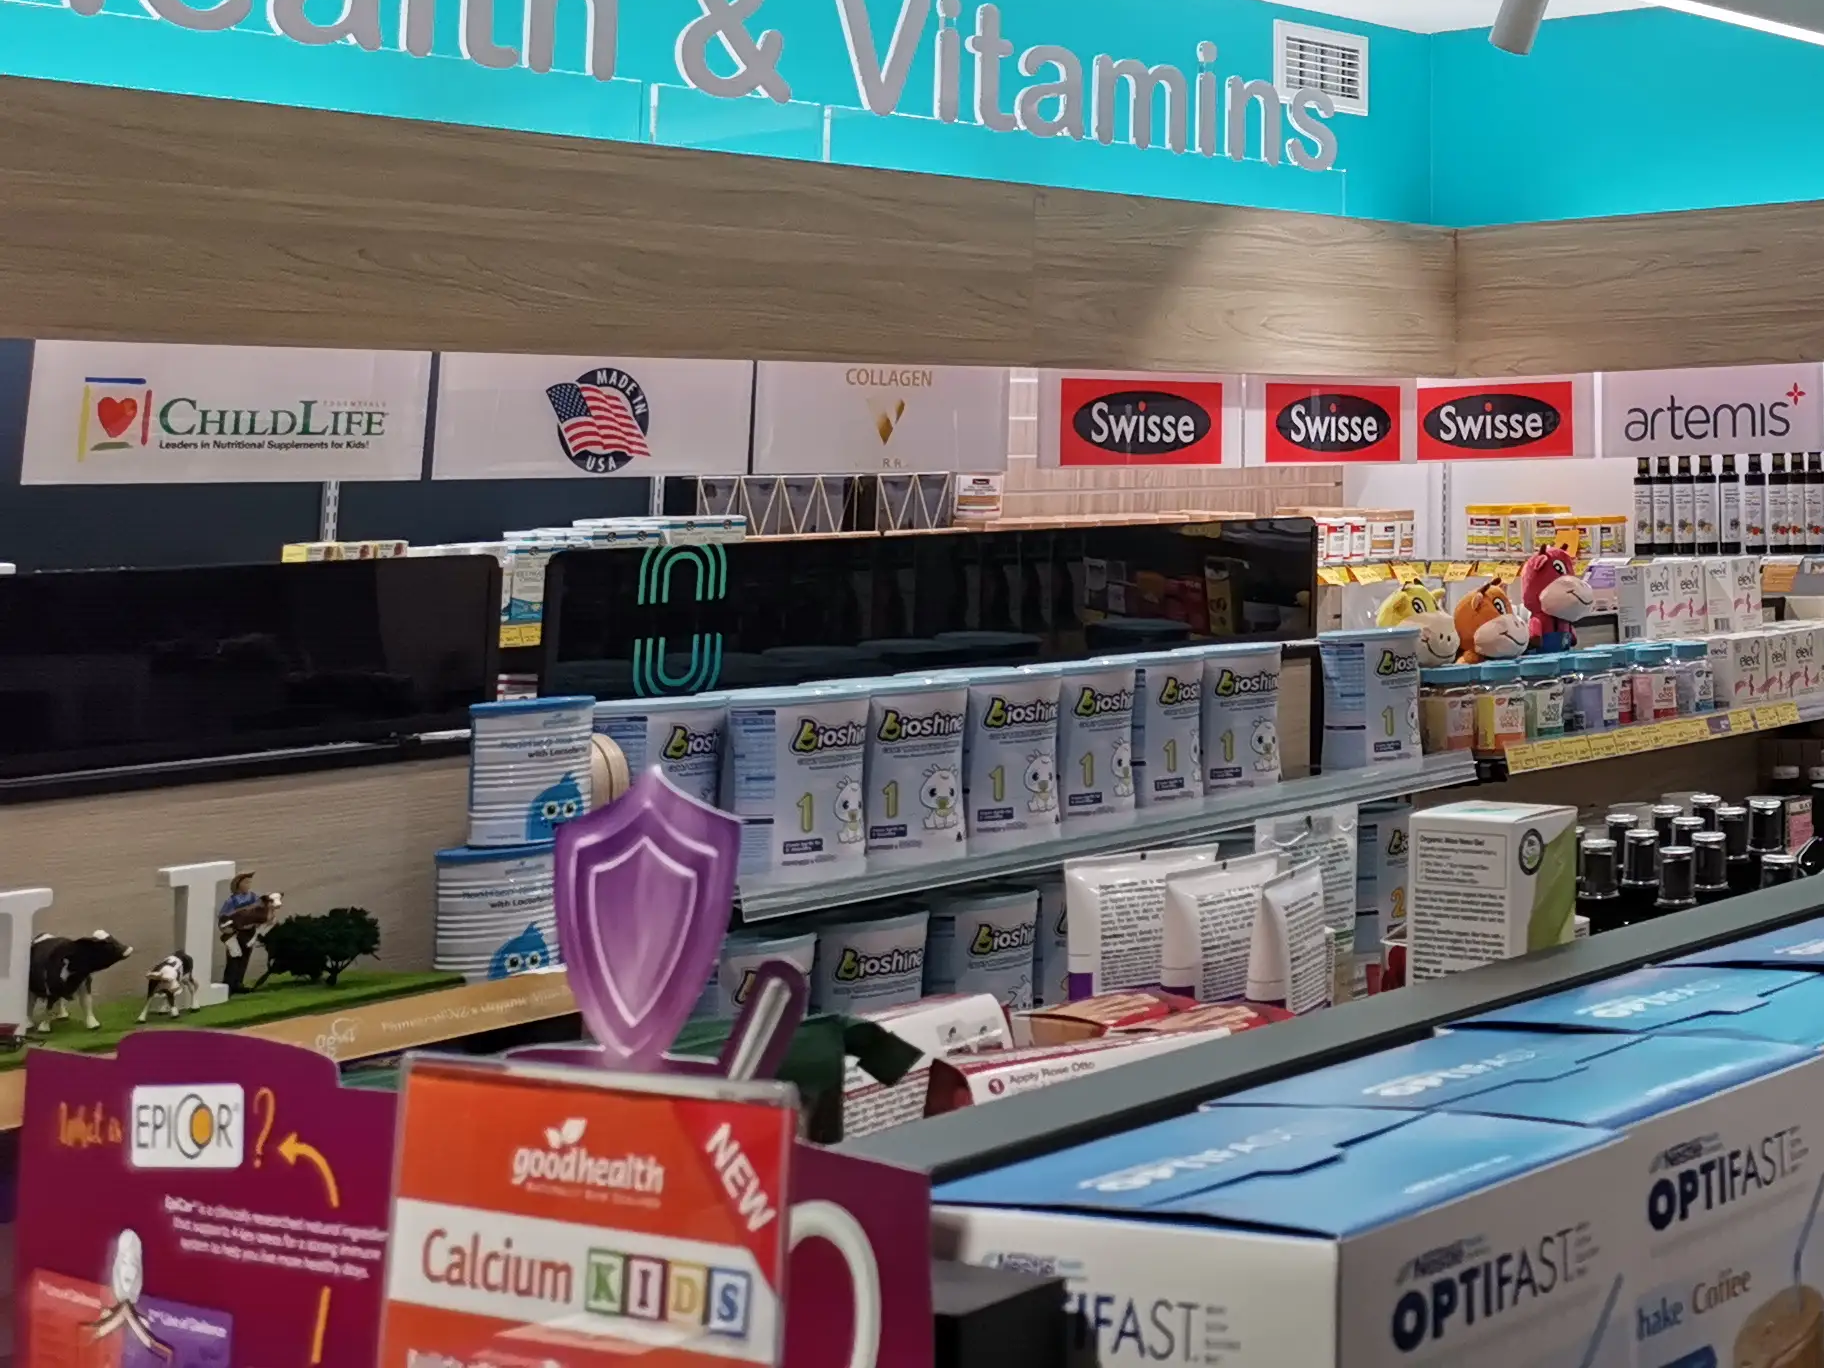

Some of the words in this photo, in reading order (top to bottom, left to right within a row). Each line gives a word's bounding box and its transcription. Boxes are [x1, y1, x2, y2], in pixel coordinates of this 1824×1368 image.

[596, 370, 637, 395] MADE
[633, 395, 648, 415] IN
[845, 368, 933, 388] COLLAGEN
[1091, 400, 1195, 443] Swisse
[1290, 403, 1378, 442] Swisse
[1439, 402, 1543, 441] Swisse
[1624, 394, 1791, 443] artemis
[159, 440, 198, 449] Leaders
[213, 440, 265, 449] Nutritional
[267, 440, 328, 450] Supplements
[331, 440, 343, 449] for
[346, 440, 369, 449] Kids!
[586, 456, 616, 472] USA
[1009, 1072, 1039, 1089] Apply
[1041, 1066, 1068, 1081] Rose
[136, 1093, 235, 1160] EPICOR
[512, 1146, 664, 1194] goodhealth
[706, 1122, 776, 1232] NEW
[1649, 1130, 1792, 1231] OPTIFAST
[422, 1229, 573, 1304] Calcium
[587, 1250, 750, 1332] KIDS
[1392, 1226, 1575, 1352] OPTIFAST
[1637, 1295, 1684, 1342] hake
[1691, 1266, 1752, 1316] Coffee
